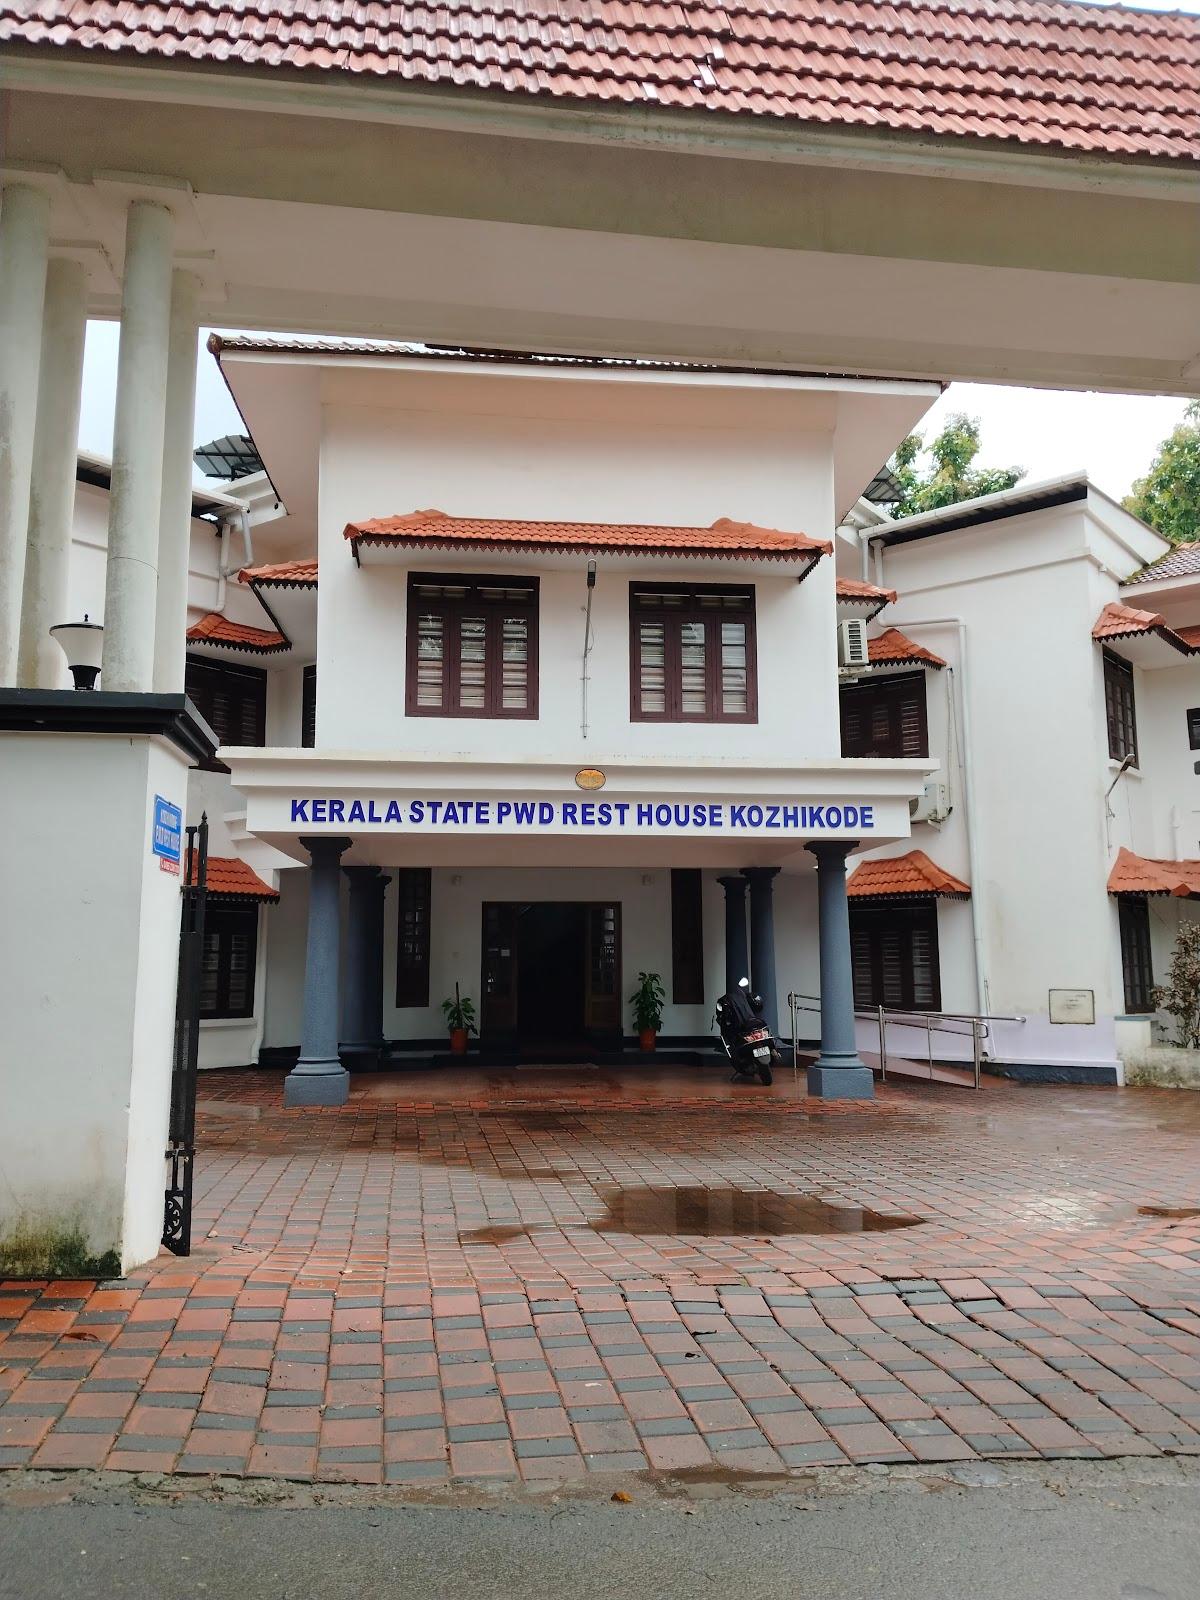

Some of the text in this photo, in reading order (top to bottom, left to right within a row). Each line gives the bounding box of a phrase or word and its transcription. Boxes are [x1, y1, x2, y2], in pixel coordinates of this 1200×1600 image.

[290, 799, 875, 829] KERALA STATE PWD REST HOUSE KOZHIKODE
